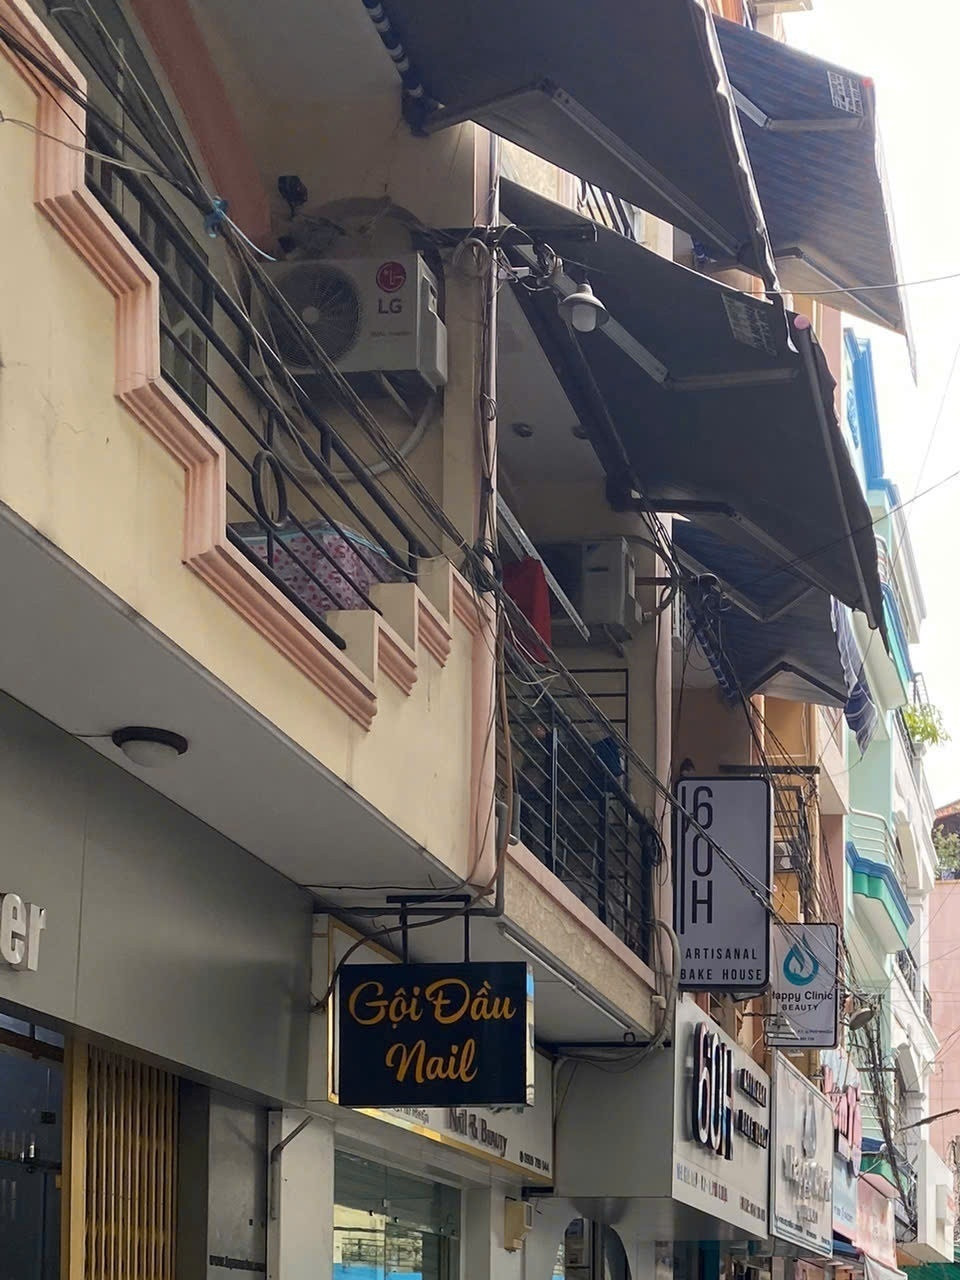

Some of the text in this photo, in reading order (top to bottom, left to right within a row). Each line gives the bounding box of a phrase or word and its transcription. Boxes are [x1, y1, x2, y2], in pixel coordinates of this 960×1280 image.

[378, 298, 402, 314] LG
[685, 948, 757, 960] ARTISANAL
[680, 968, 763, 980] BAKE HOUSE
[804, 990, 833, 1000] Clinic
[349, 978, 517, 1029] Gội Đầu
[385, 1038, 479, 1083] Nail
